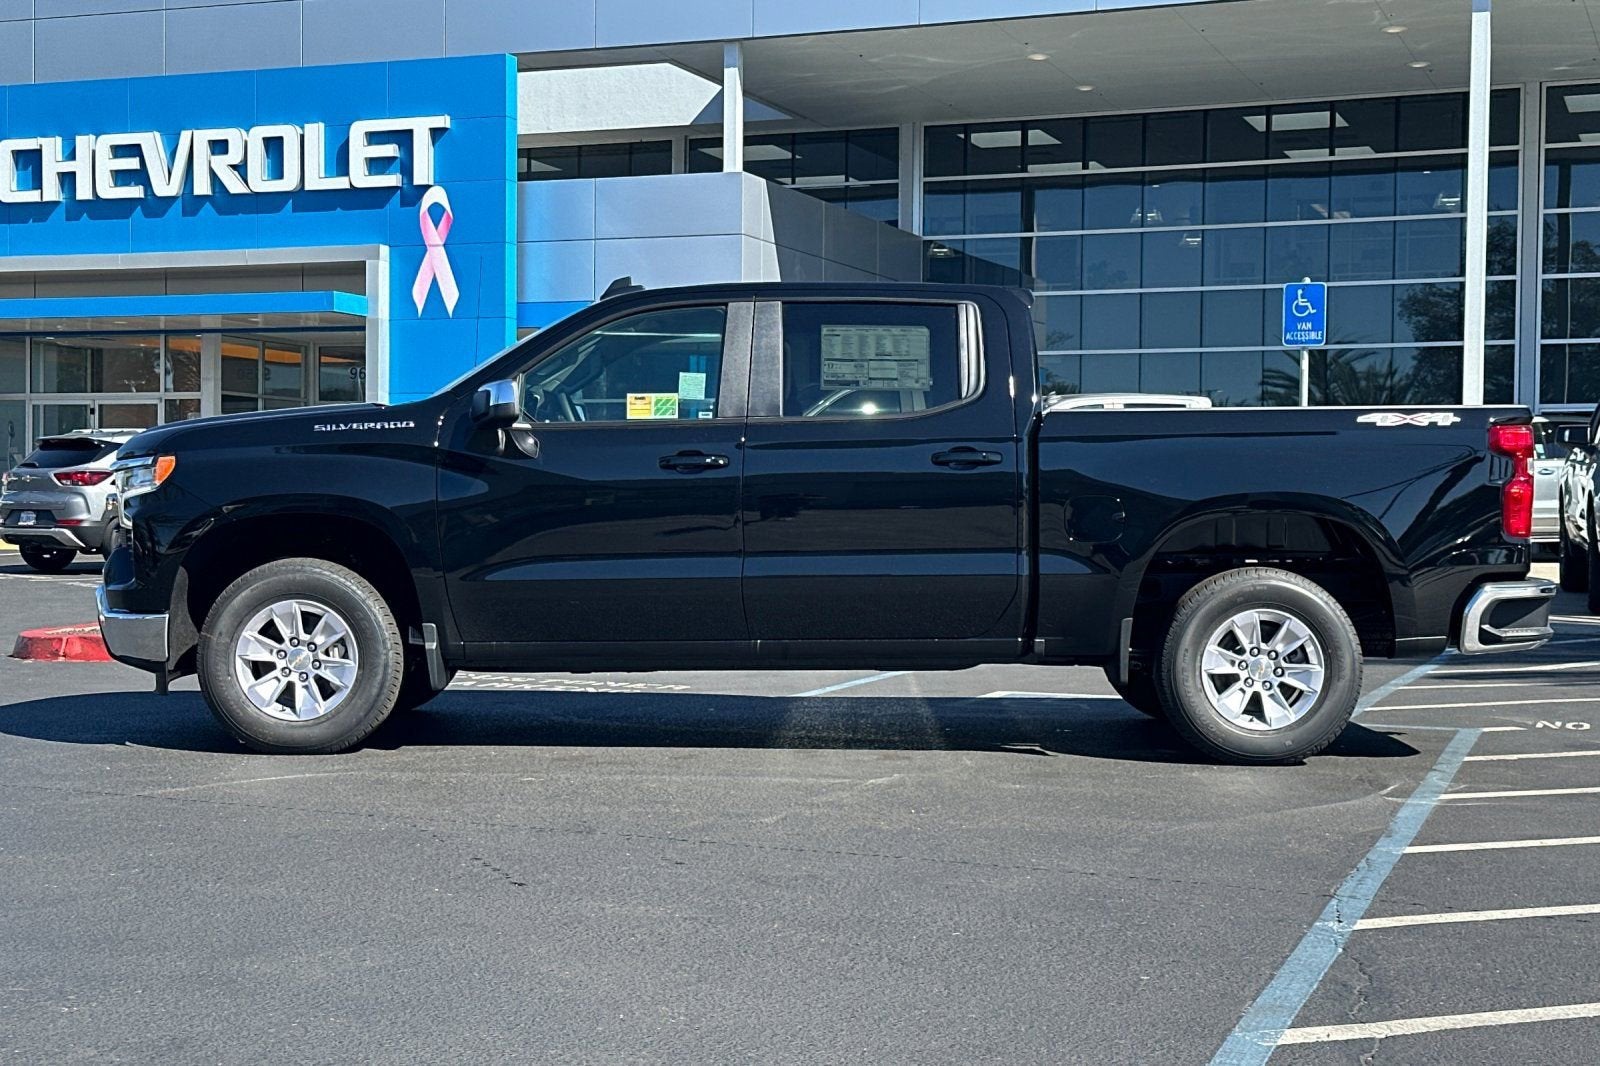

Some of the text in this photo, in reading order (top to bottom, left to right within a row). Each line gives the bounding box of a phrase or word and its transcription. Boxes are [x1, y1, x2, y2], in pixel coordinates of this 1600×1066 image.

[0, 115, 450, 202] CHEVROLET
[1297, 322, 1312, 330] VAN
[1286, 331, 1323, 340] ACCESSIBLE
[313, 421, 415, 432] SILVERADO
[1535, 720, 1591, 731] NO
